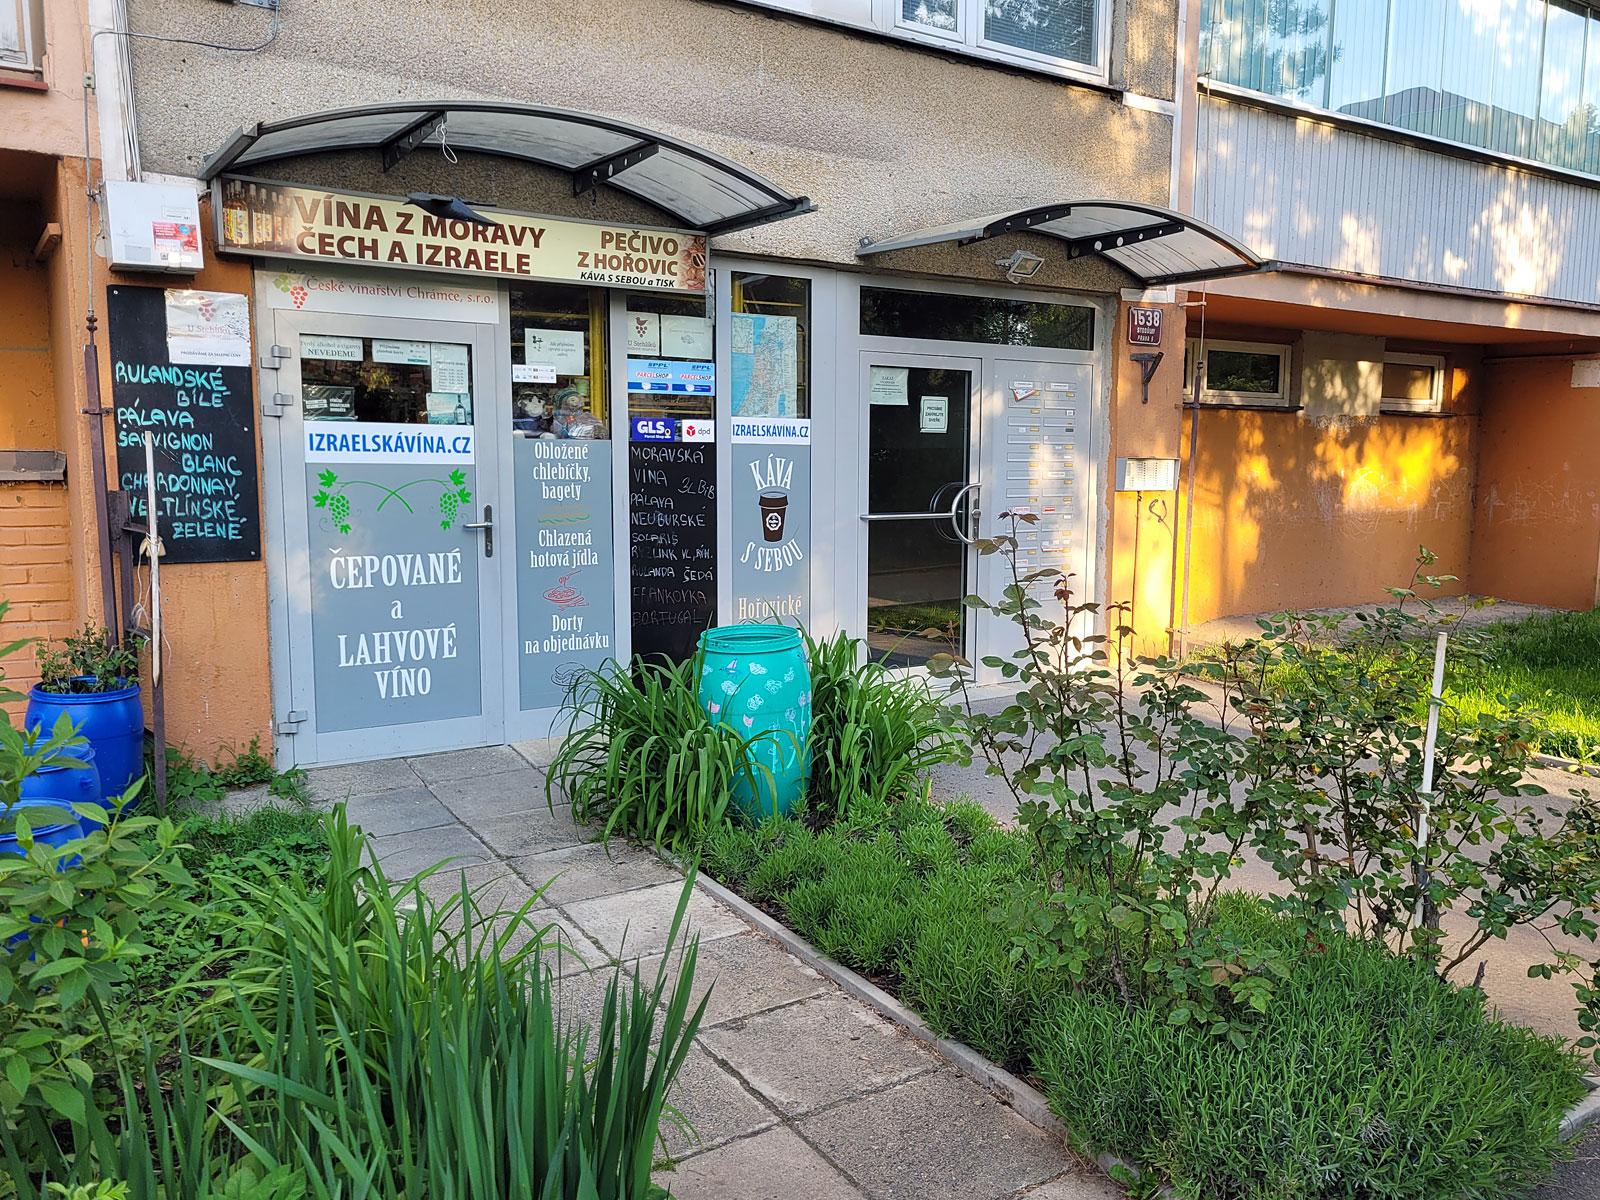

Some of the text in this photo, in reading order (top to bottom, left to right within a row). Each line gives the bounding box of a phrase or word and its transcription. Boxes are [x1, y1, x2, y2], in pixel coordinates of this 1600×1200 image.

[293, 195, 546, 248] VÍNA Z MORAVY
[296, 226, 531, 274] ČECH A IZRAELE
[601, 230, 679, 256] PEČIVO
[577, 251, 678, 276] Z HOŘOVIC
[306, 275, 494, 304] České vinařství Chrámce, s.r.o.
[580, 270, 605, 282] KÁVA
[607, 274, 613, 282] S
[615, 275, 646, 285] SEBOU
[656, 278, 675, 288] TISK
[1132, 310, 1160, 327] 1538
[308, 348, 356, 358] NEVEDEME
[115, 361, 227, 391] RULANDSKÉ
[177, 390, 231, 408] BÍLÉ
[117, 397, 194, 428] PÁLAVA
[637, 420, 665, 434] GLS
[698, 427, 711, 437] dpd
[732, 423, 809, 438] IZRAELSKÁVÍNA.CZ
[308, 432, 471, 454] IZRAELSKÁVÍNA.CZ
[534, 441, 589, 460] Obložené
[631, 445, 705, 464] MORAVSKÁ
[182, 455, 243, 476] BLANC
[533, 462, 591, 482] chlebíčky,
[750, 454, 793, 490] KÁVA
[542, 482, 581, 501] bagety
[630, 488, 674, 510] PÁLAVA
[631, 506, 706, 527] NEUBURSKÉ
[172, 516, 247, 540] ZELENÉ
[538, 529, 592, 547] Chlazená
[530, 548, 598, 568] hotová jídla
[741, 539, 804, 572] S SEBOU
[329, 547, 462, 589] ČEPOVANÉ
[682, 566, 713, 583] ŠEDÁ
[391, 599, 403, 619] a
[739, 595, 802, 620] Hořovické
[552, 614, 583, 632] Dorty
[337, 622, 457, 667] LAHVOVÉ
[525, 632, 610, 654] na objednávku
[374, 665, 431, 699] VÍNO
